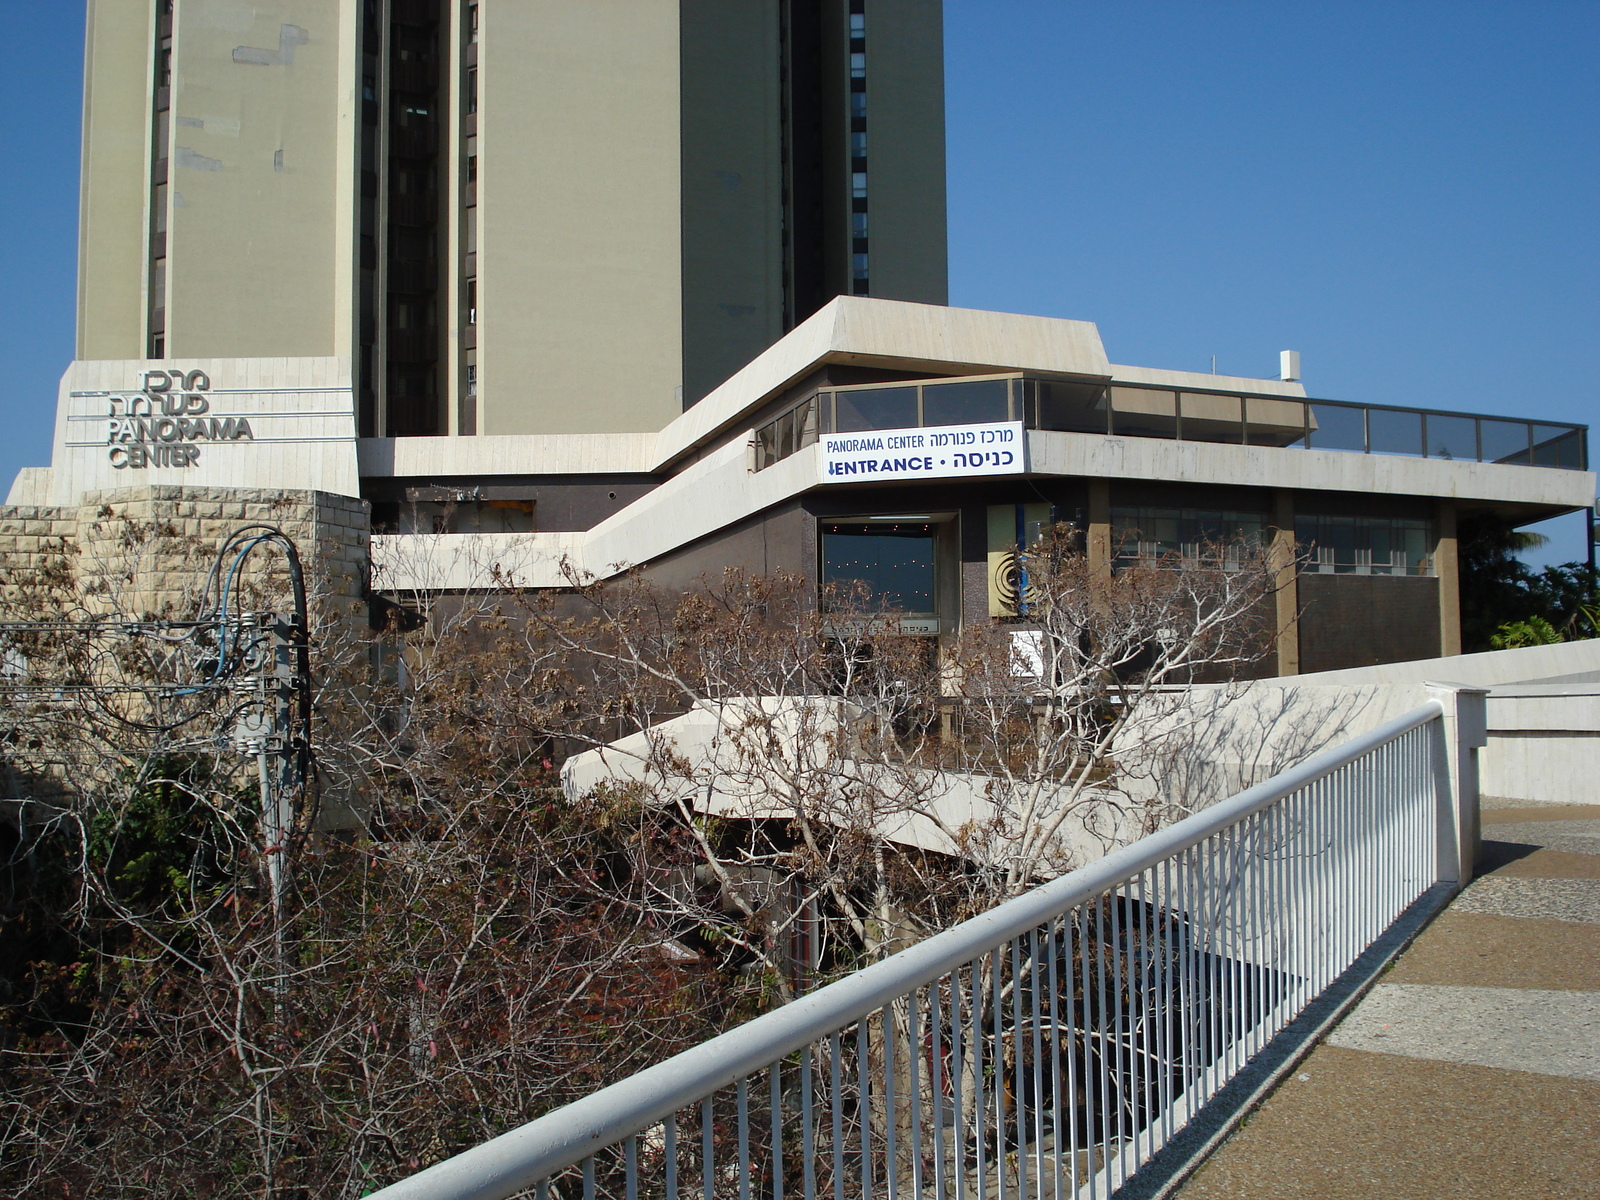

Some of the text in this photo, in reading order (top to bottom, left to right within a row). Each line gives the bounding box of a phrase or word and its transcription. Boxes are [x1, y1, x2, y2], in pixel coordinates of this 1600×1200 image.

[138, 369, 210, 392] מרכז
[109, 394, 209, 417] פנורמה
[108, 417, 253, 442] PANORAMA
[930, 429, 1014, 447] מרכז פנורמה
[827, 435, 924, 453] PANORAMA CENTER
[108, 443, 200, 468] CENTER
[953, 451, 1014, 468] כניסה
[835, 457, 933, 475] ENTRANCE
